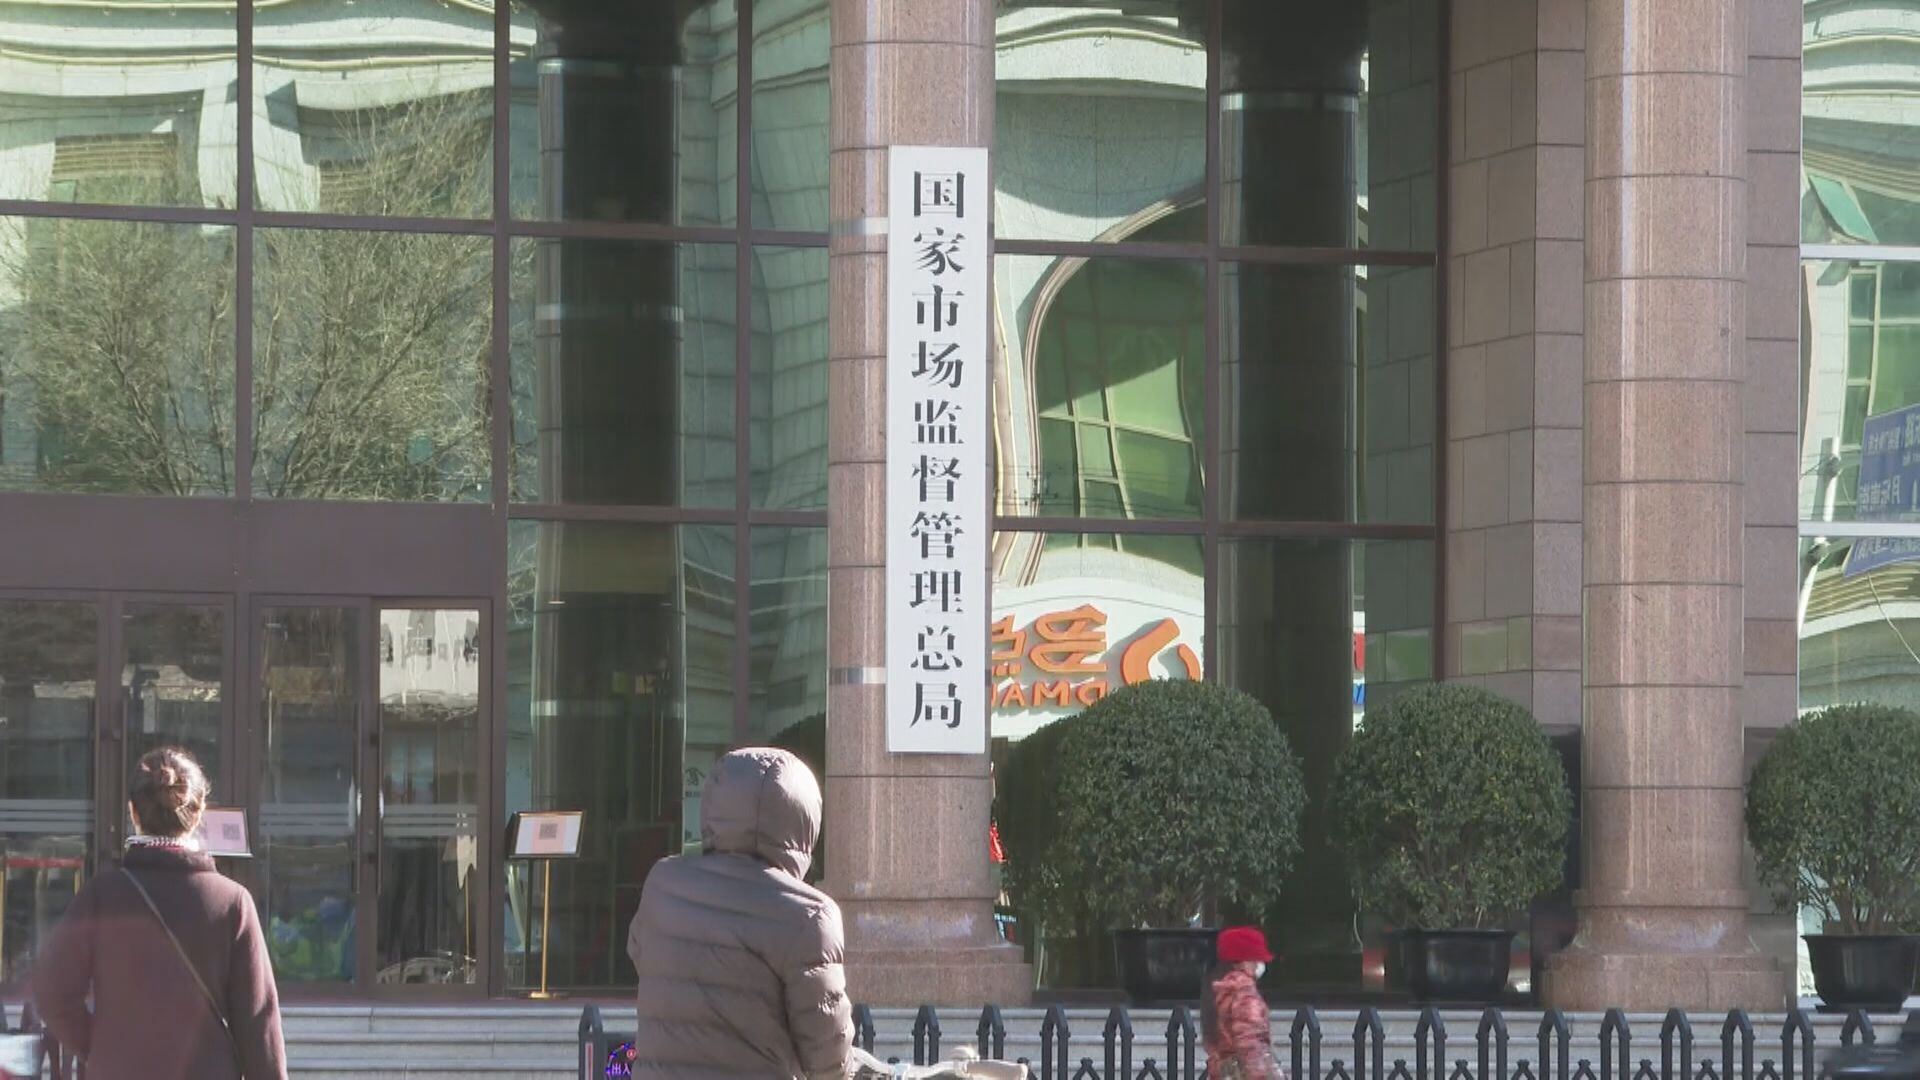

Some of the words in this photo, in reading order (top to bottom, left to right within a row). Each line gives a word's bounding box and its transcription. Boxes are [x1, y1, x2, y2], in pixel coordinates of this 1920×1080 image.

[908, 170, 966, 730] 国家市场监督管理总局
